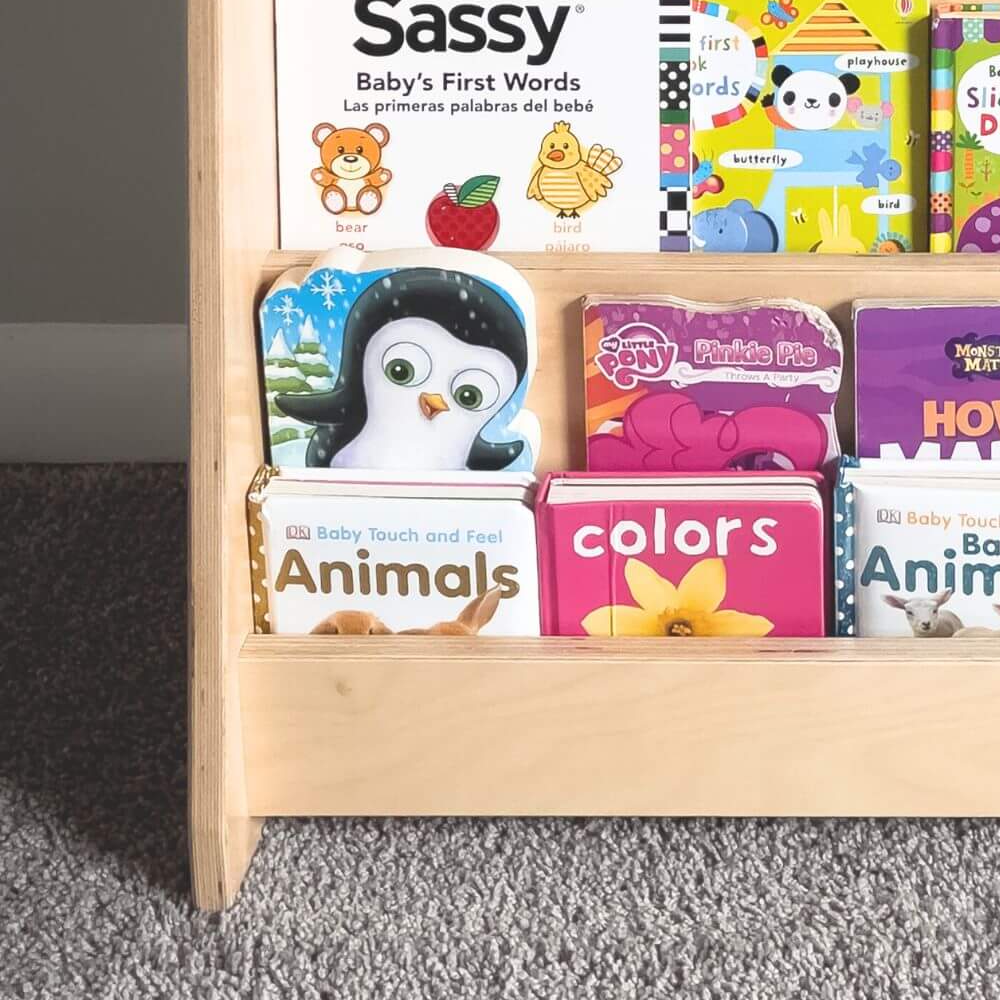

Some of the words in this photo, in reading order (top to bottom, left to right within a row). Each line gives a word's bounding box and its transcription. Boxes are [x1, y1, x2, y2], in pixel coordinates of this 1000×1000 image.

[700, 35, 739, 51] first
[847, 56, 908, 67] playhouse
[356, 72, 433, 96] Baby's
[443, 72, 496, 91] First
[504, 71, 581, 91] Words
[343, 99, 369, 112] Las
[375, 99, 445, 116] primeras
[450, 98, 518, 116] palabras
[523, 99, 548, 113] del
[553, 98, 594, 113] bebé
[733, 154, 787, 166] butterfly
[878, 198, 901, 210] bird
[336, 220, 368, 233] bear
[553, 222, 582, 233] bird
[622, 341, 655, 349] LITTLE
[694, 339, 773, 367] Pinkie
[777, 341, 818, 367] Pie
[597, 344, 677, 385] PONY
[725, 372, 761, 382] Throws
[763, 373, 771, 382] A
[774, 373, 800, 384] Party
[877, 509, 901, 524] DK
[907, 511, 951, 530] Baby
[286, 526, 310, 540] DK
[317, 527, 362, 544] Baby
[369, 528, 418, 543] Touch
[426, 530, 459, 543] and
[466, 531, 503, 543] Feel
[573, 508, 778, 557] colors
[275, 548, 520, 599] Animals
